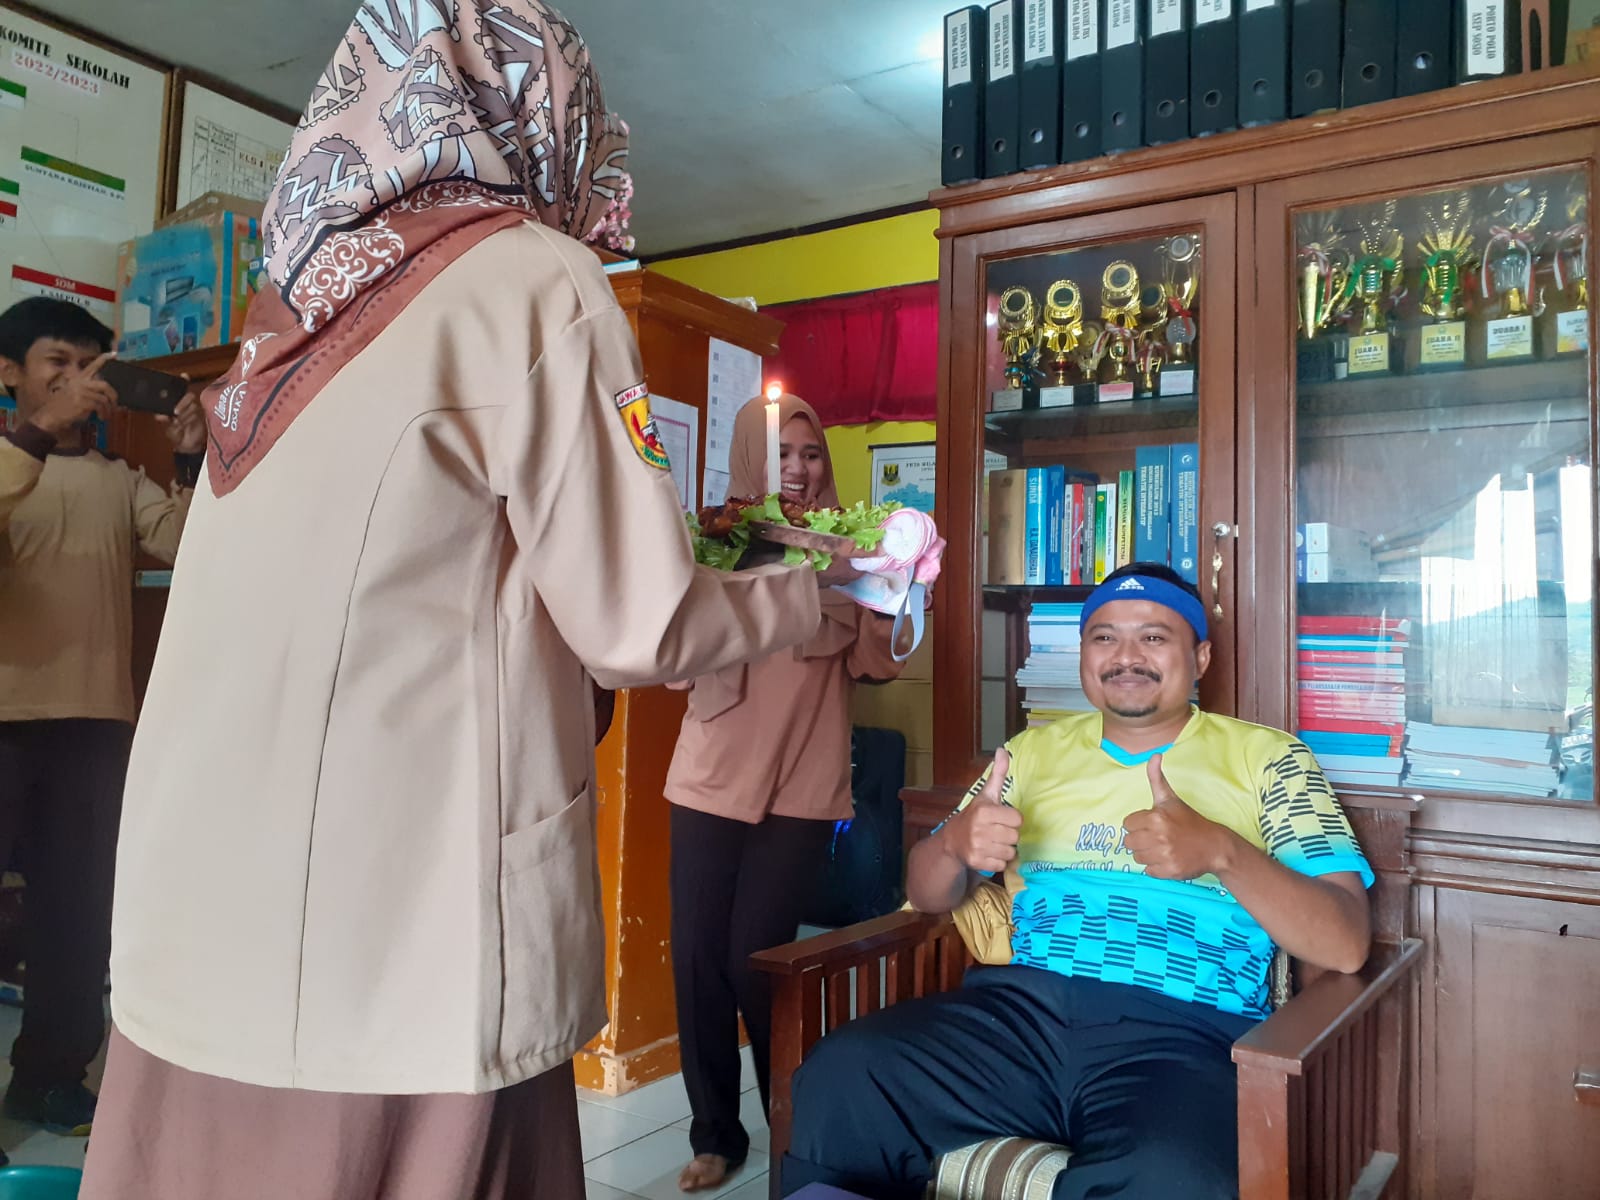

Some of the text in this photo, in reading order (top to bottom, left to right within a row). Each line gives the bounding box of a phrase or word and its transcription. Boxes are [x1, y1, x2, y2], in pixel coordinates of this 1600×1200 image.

[1072, 17, 1080, 41] PORTO
[1472, 12, 1482, 31] ASEP
[1486, 5, 1497, 60] PORTO POLIO
[0, 25, 130, 89] KOMITE SEKOLAH
[15, 51, 99, 94] 2022/2023
[54, 277, 77, 291] SDM
[1028, 477, 1038, 504] SUNDA
